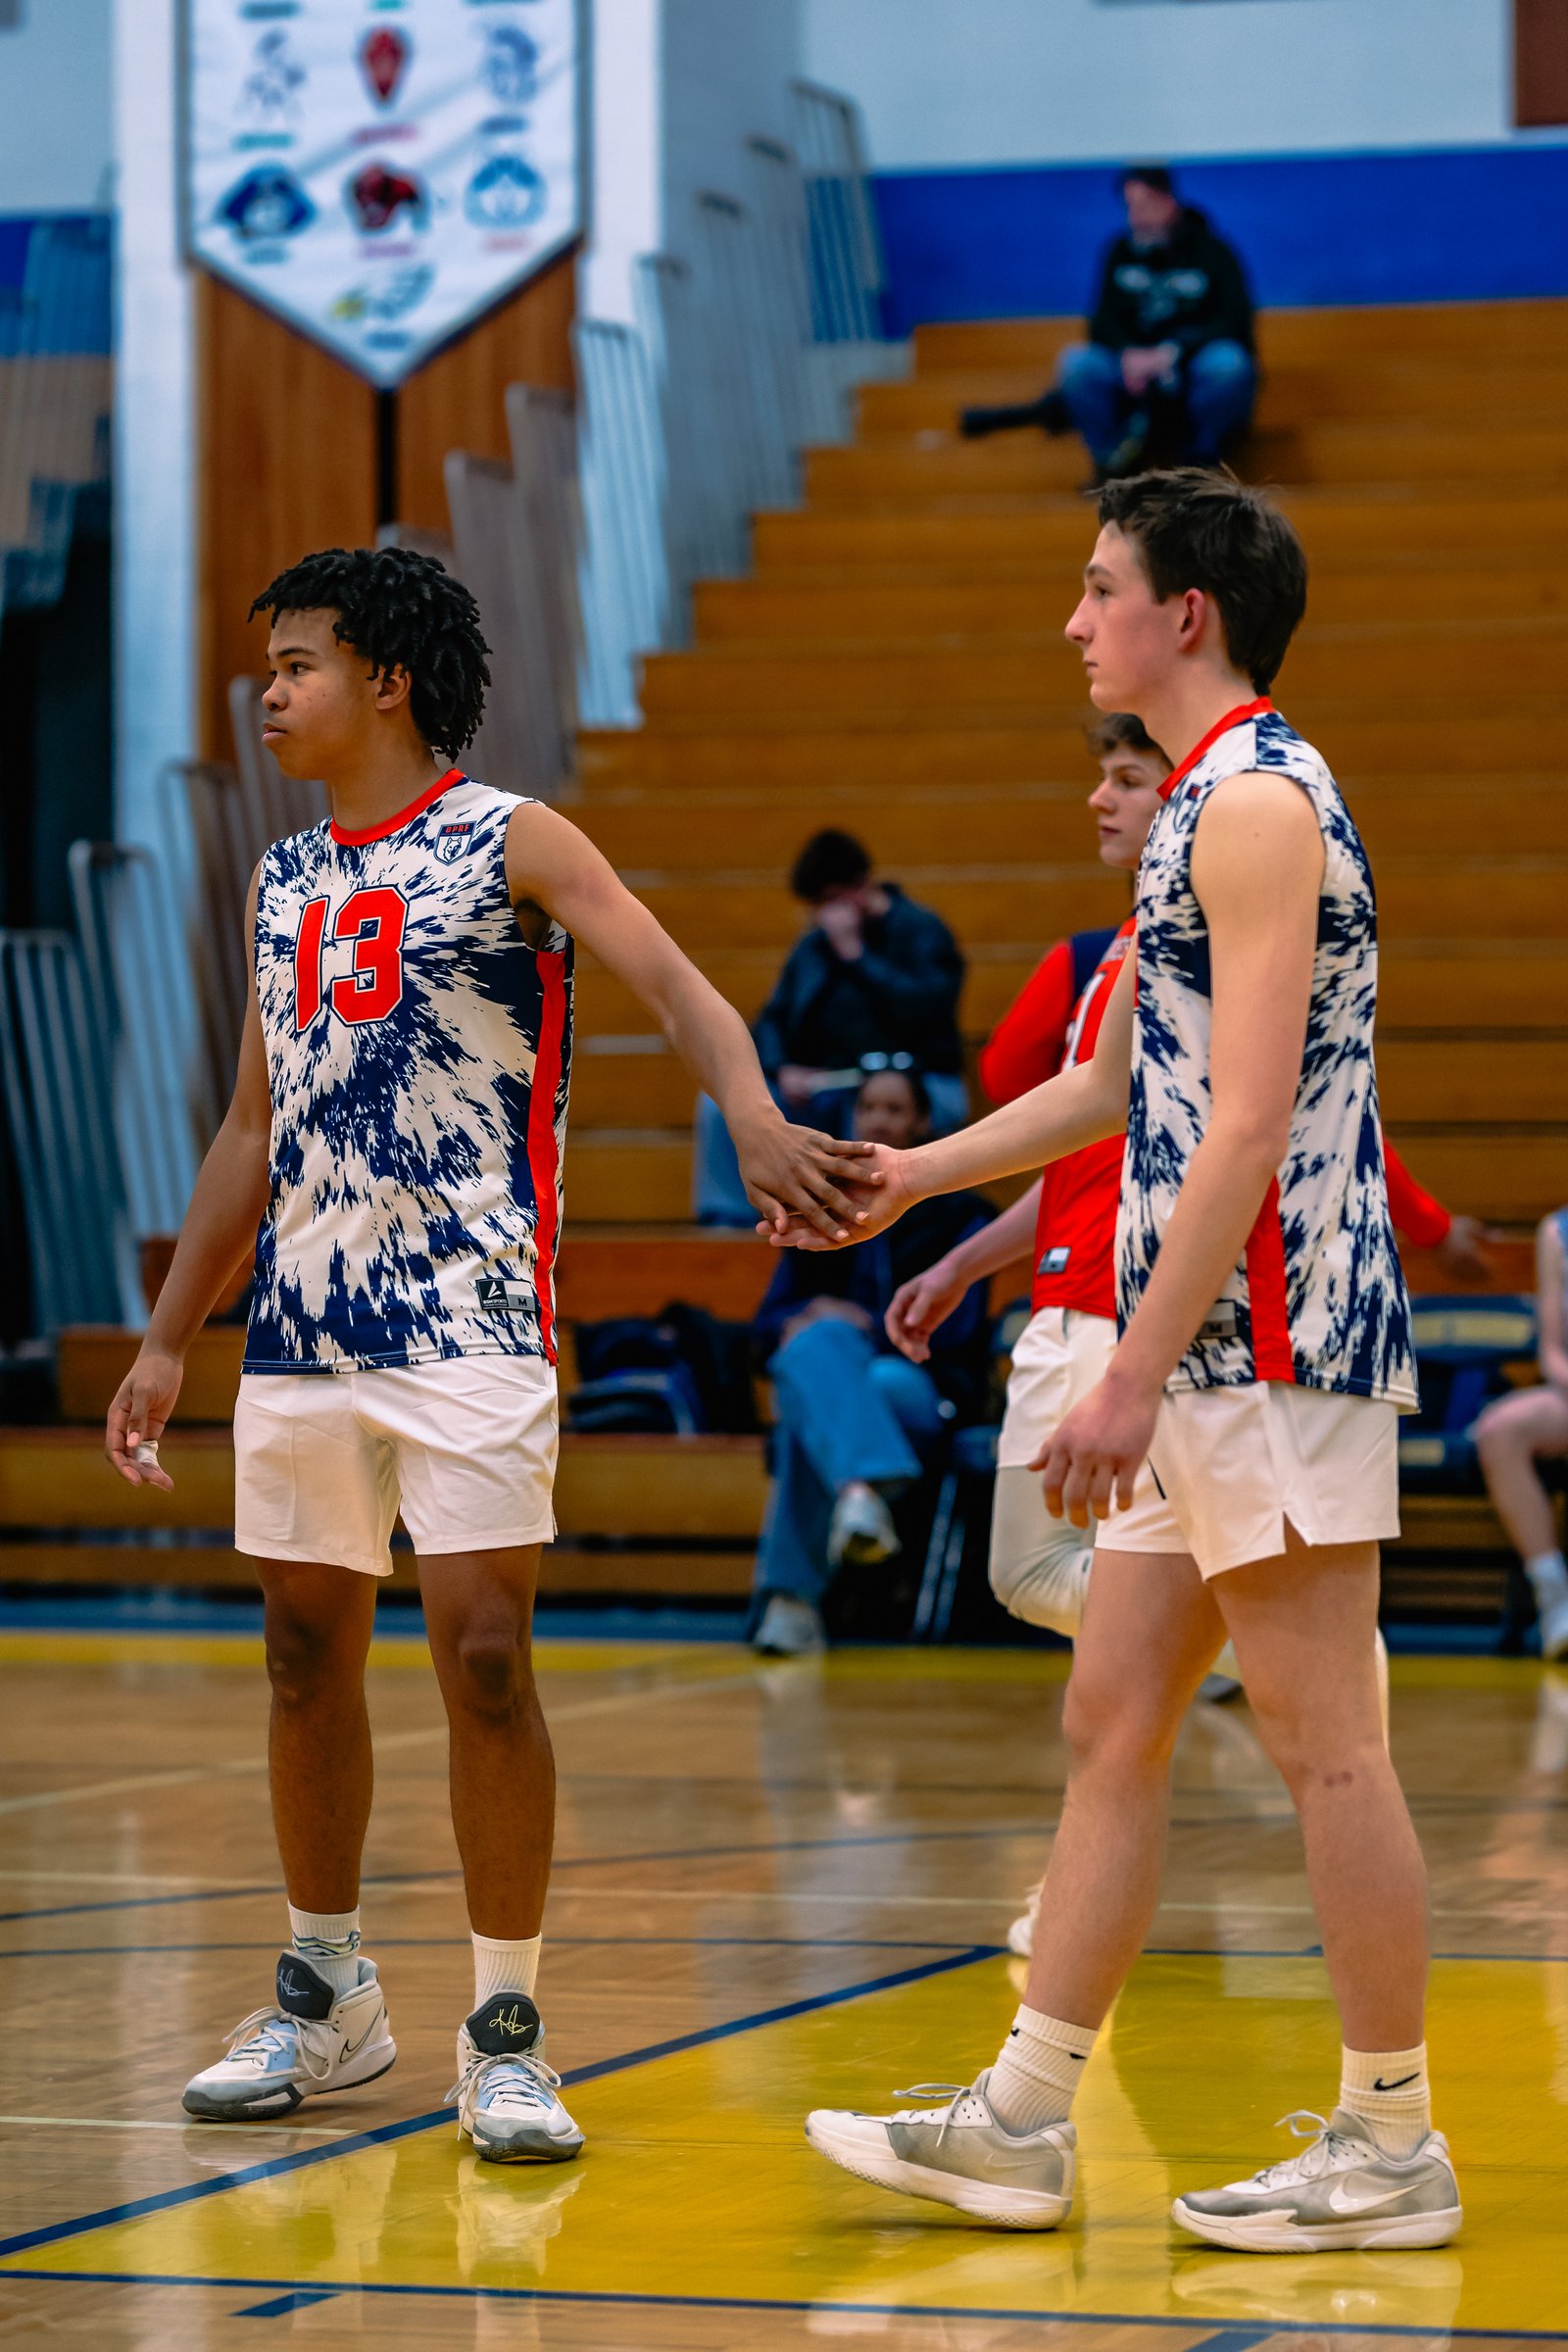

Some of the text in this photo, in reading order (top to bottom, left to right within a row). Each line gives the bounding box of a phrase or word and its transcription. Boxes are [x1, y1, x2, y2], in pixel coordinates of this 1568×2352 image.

[445, 824, 469, 833] OPRF
[295, 884, 409, 1032] 13
[517, 1298, 527, 1306] M
